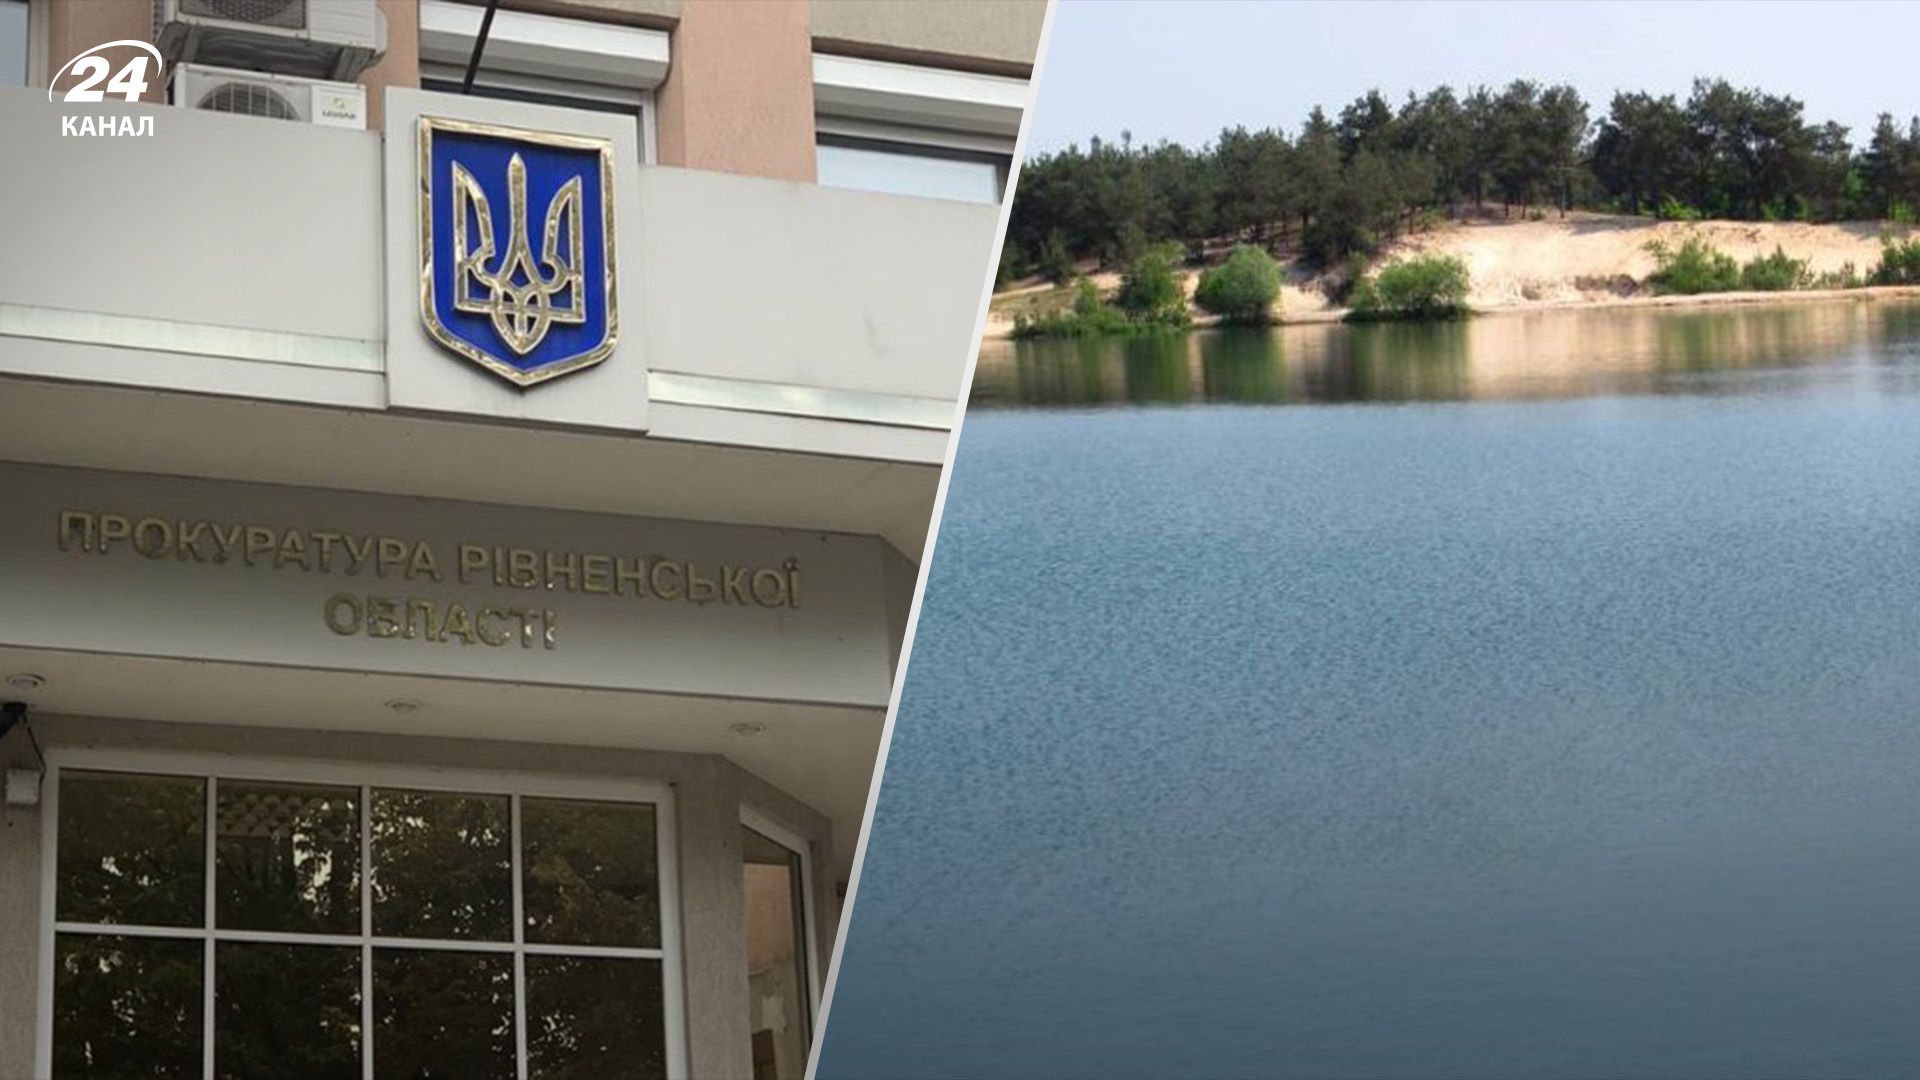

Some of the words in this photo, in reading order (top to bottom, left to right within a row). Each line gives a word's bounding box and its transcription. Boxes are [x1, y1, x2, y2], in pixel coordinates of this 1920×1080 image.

[59, 509, 442, 582] ПРОКУРАТУРА
[458, 544, 801, 608] РІВНЕНСЬКОЇ
[323, 592, 557, 650] ОБЛАСТІ
